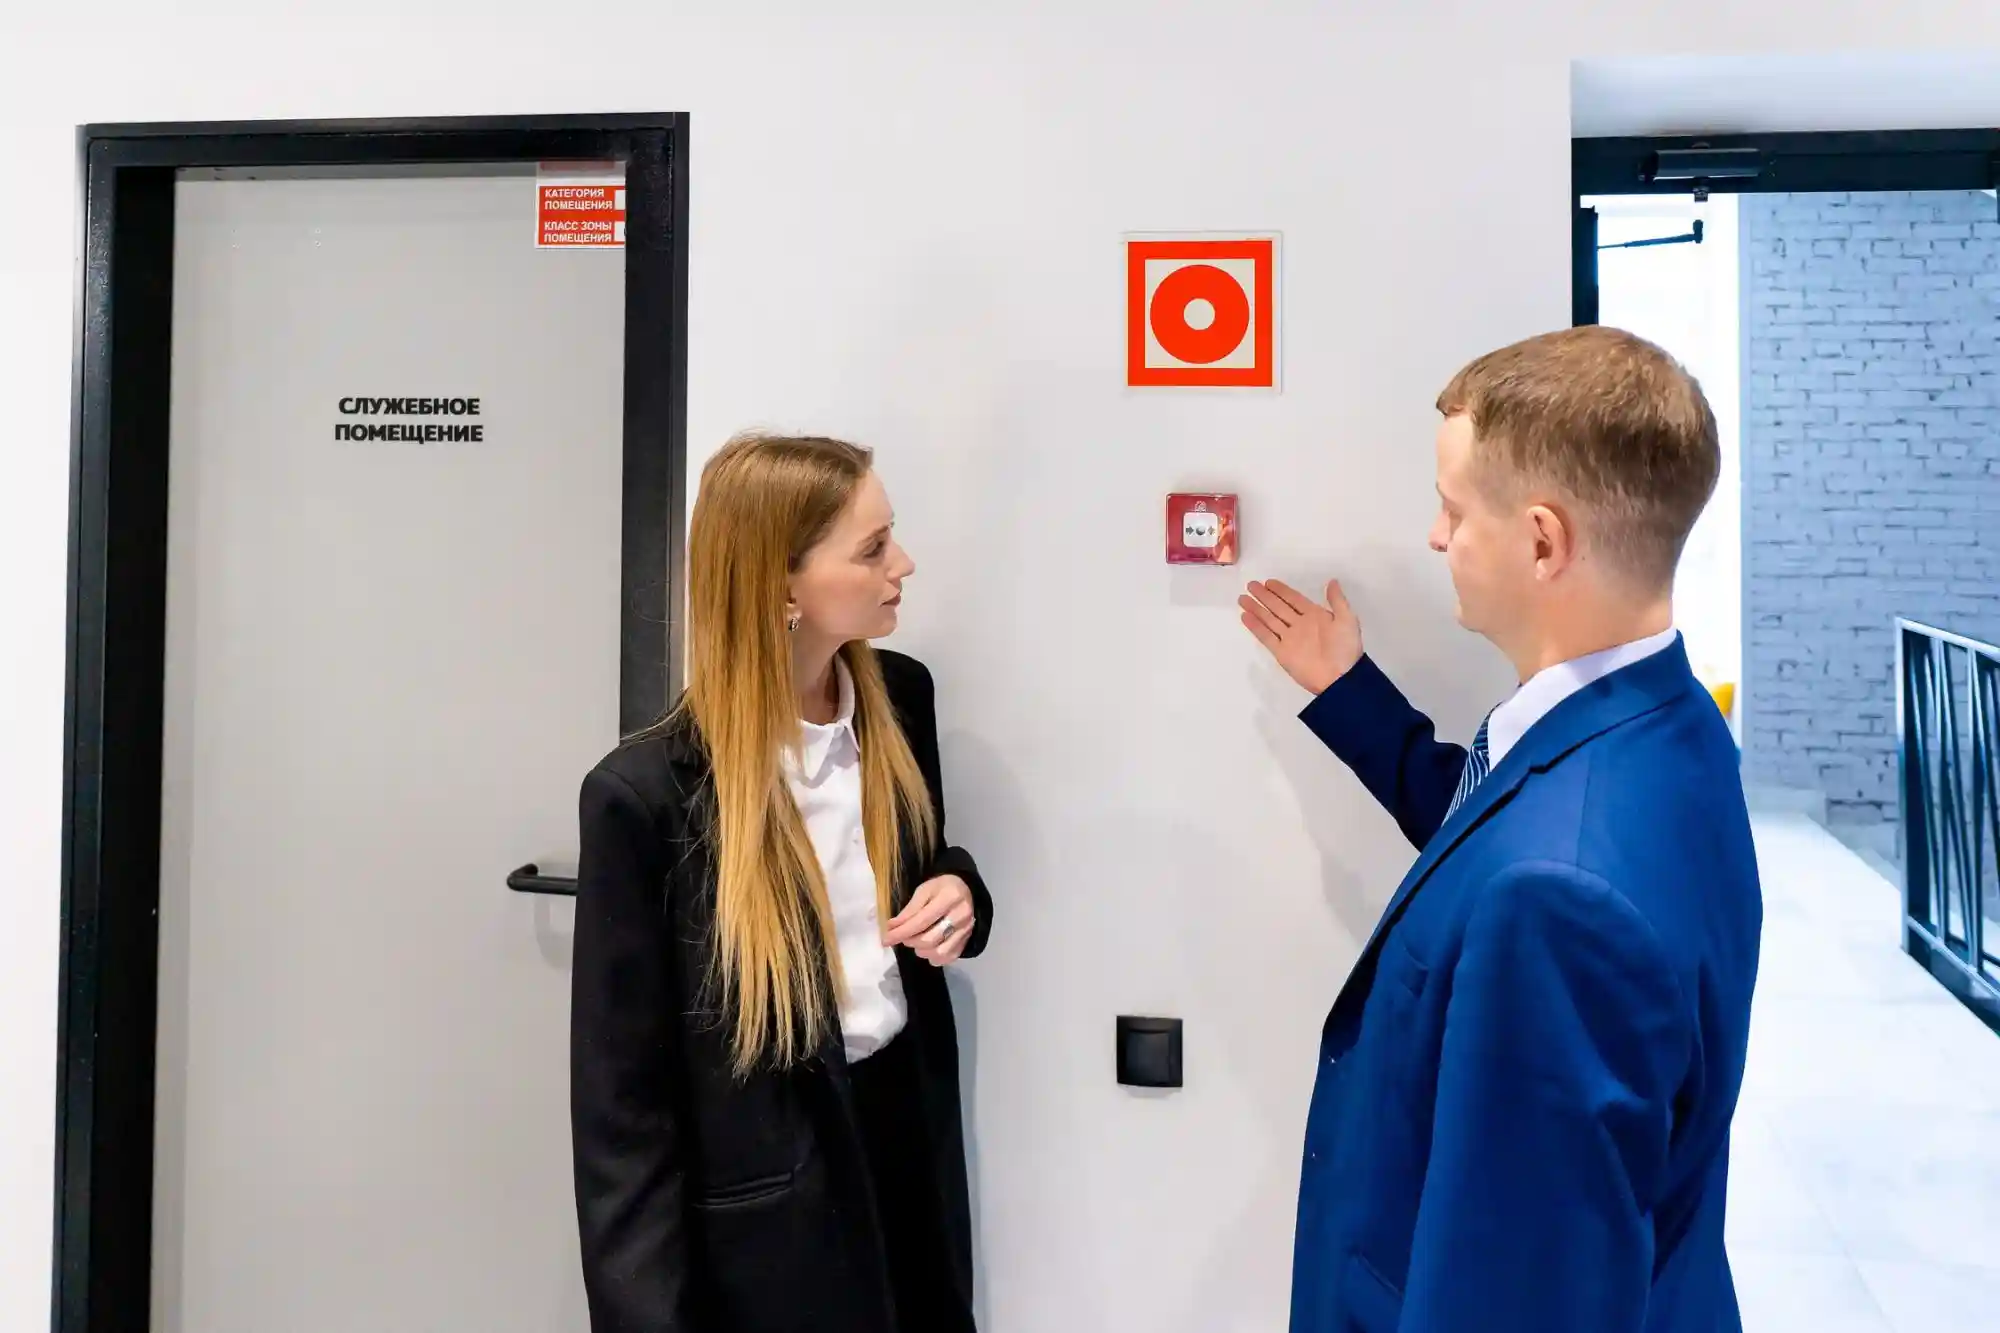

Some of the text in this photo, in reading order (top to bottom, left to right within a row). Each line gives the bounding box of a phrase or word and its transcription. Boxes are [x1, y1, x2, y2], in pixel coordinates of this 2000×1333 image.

[544, 188, 605, 198] КАТЕГОРИЯ
[544, 200, 613, 210] ПОМЕЩЕНИЯ
[544, 221, 612, 231] КЛАСС ЗОНЫ
[543, 233, 612, 244] ПОМЕЩЕНИЯ
[338, 397, 480, 415] СЛУЖЕБНОЕ
[335, 424, 484, 444] ПОМЕЩЕНИЕ
